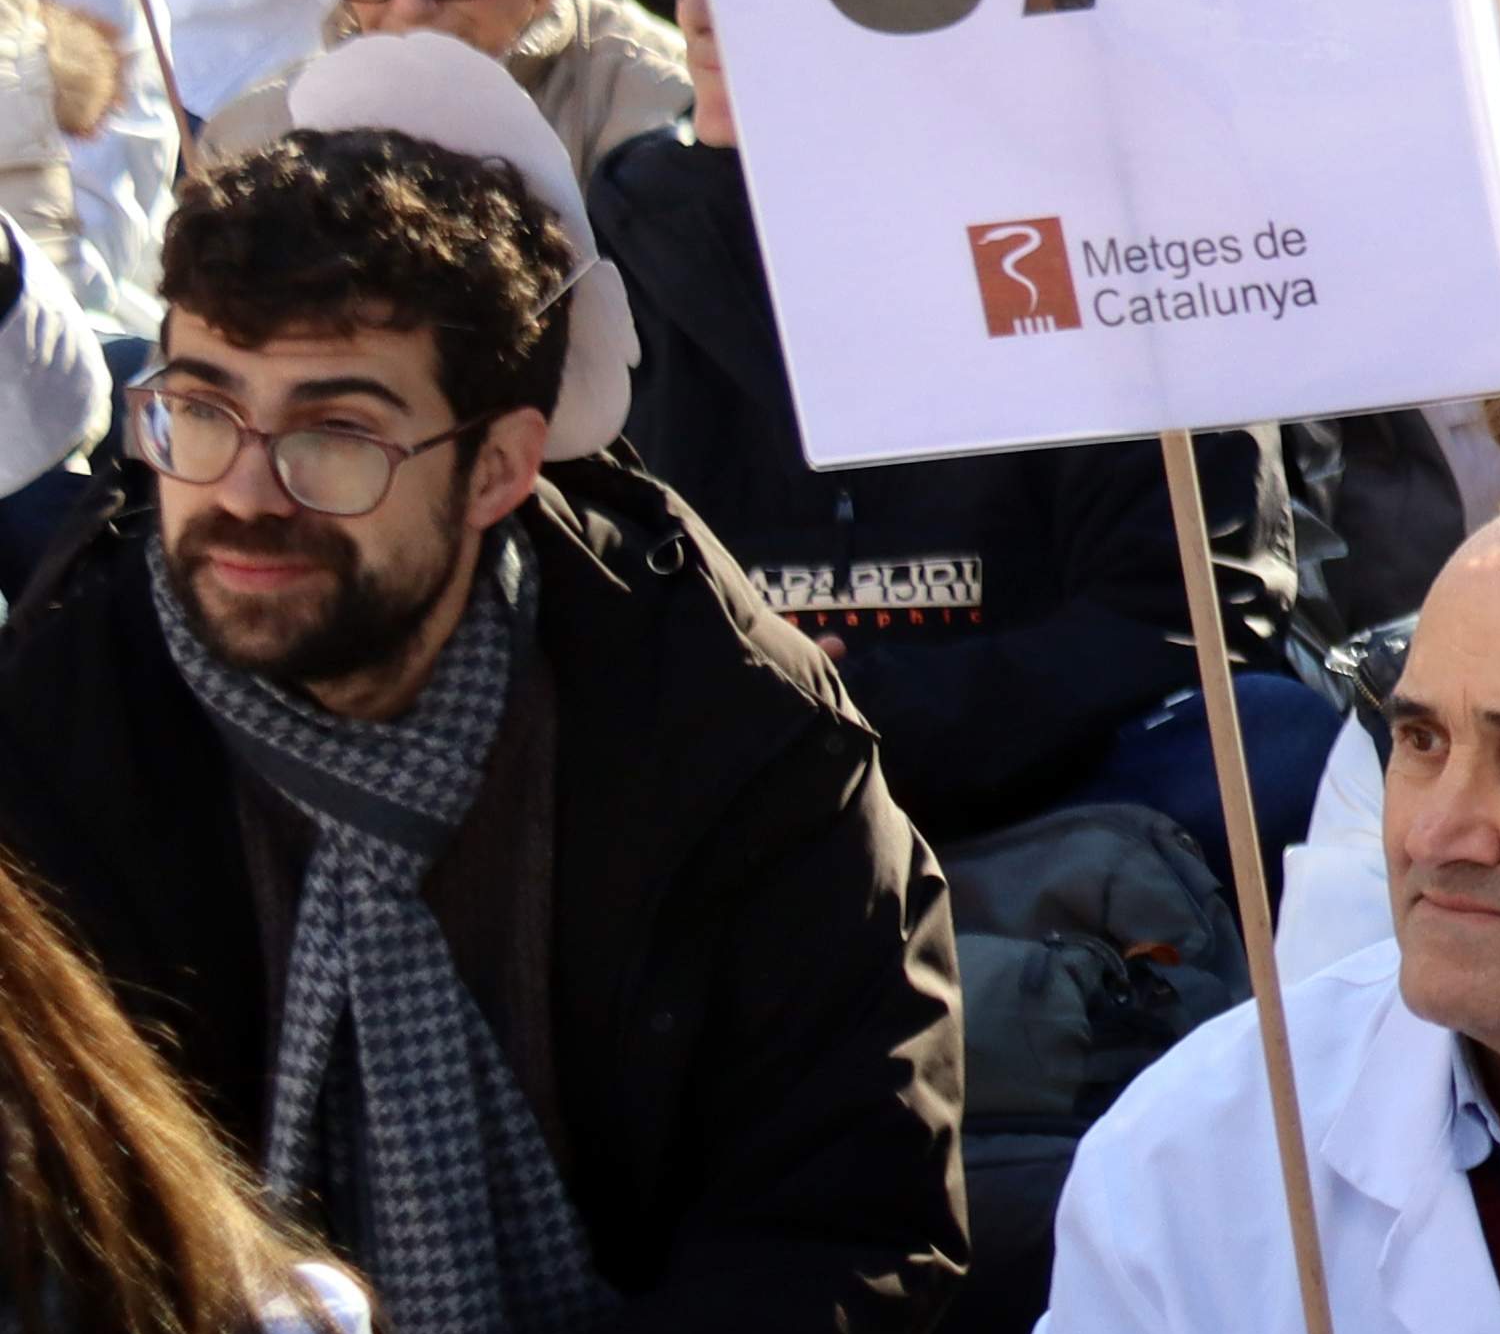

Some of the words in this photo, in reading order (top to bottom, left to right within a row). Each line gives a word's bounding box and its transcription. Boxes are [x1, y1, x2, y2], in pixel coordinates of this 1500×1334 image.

[1081, 233, 1243, 281] Metges
[1253, 218, 1308, 261] de
[1092, 275, 1319, 328] Catalunya
